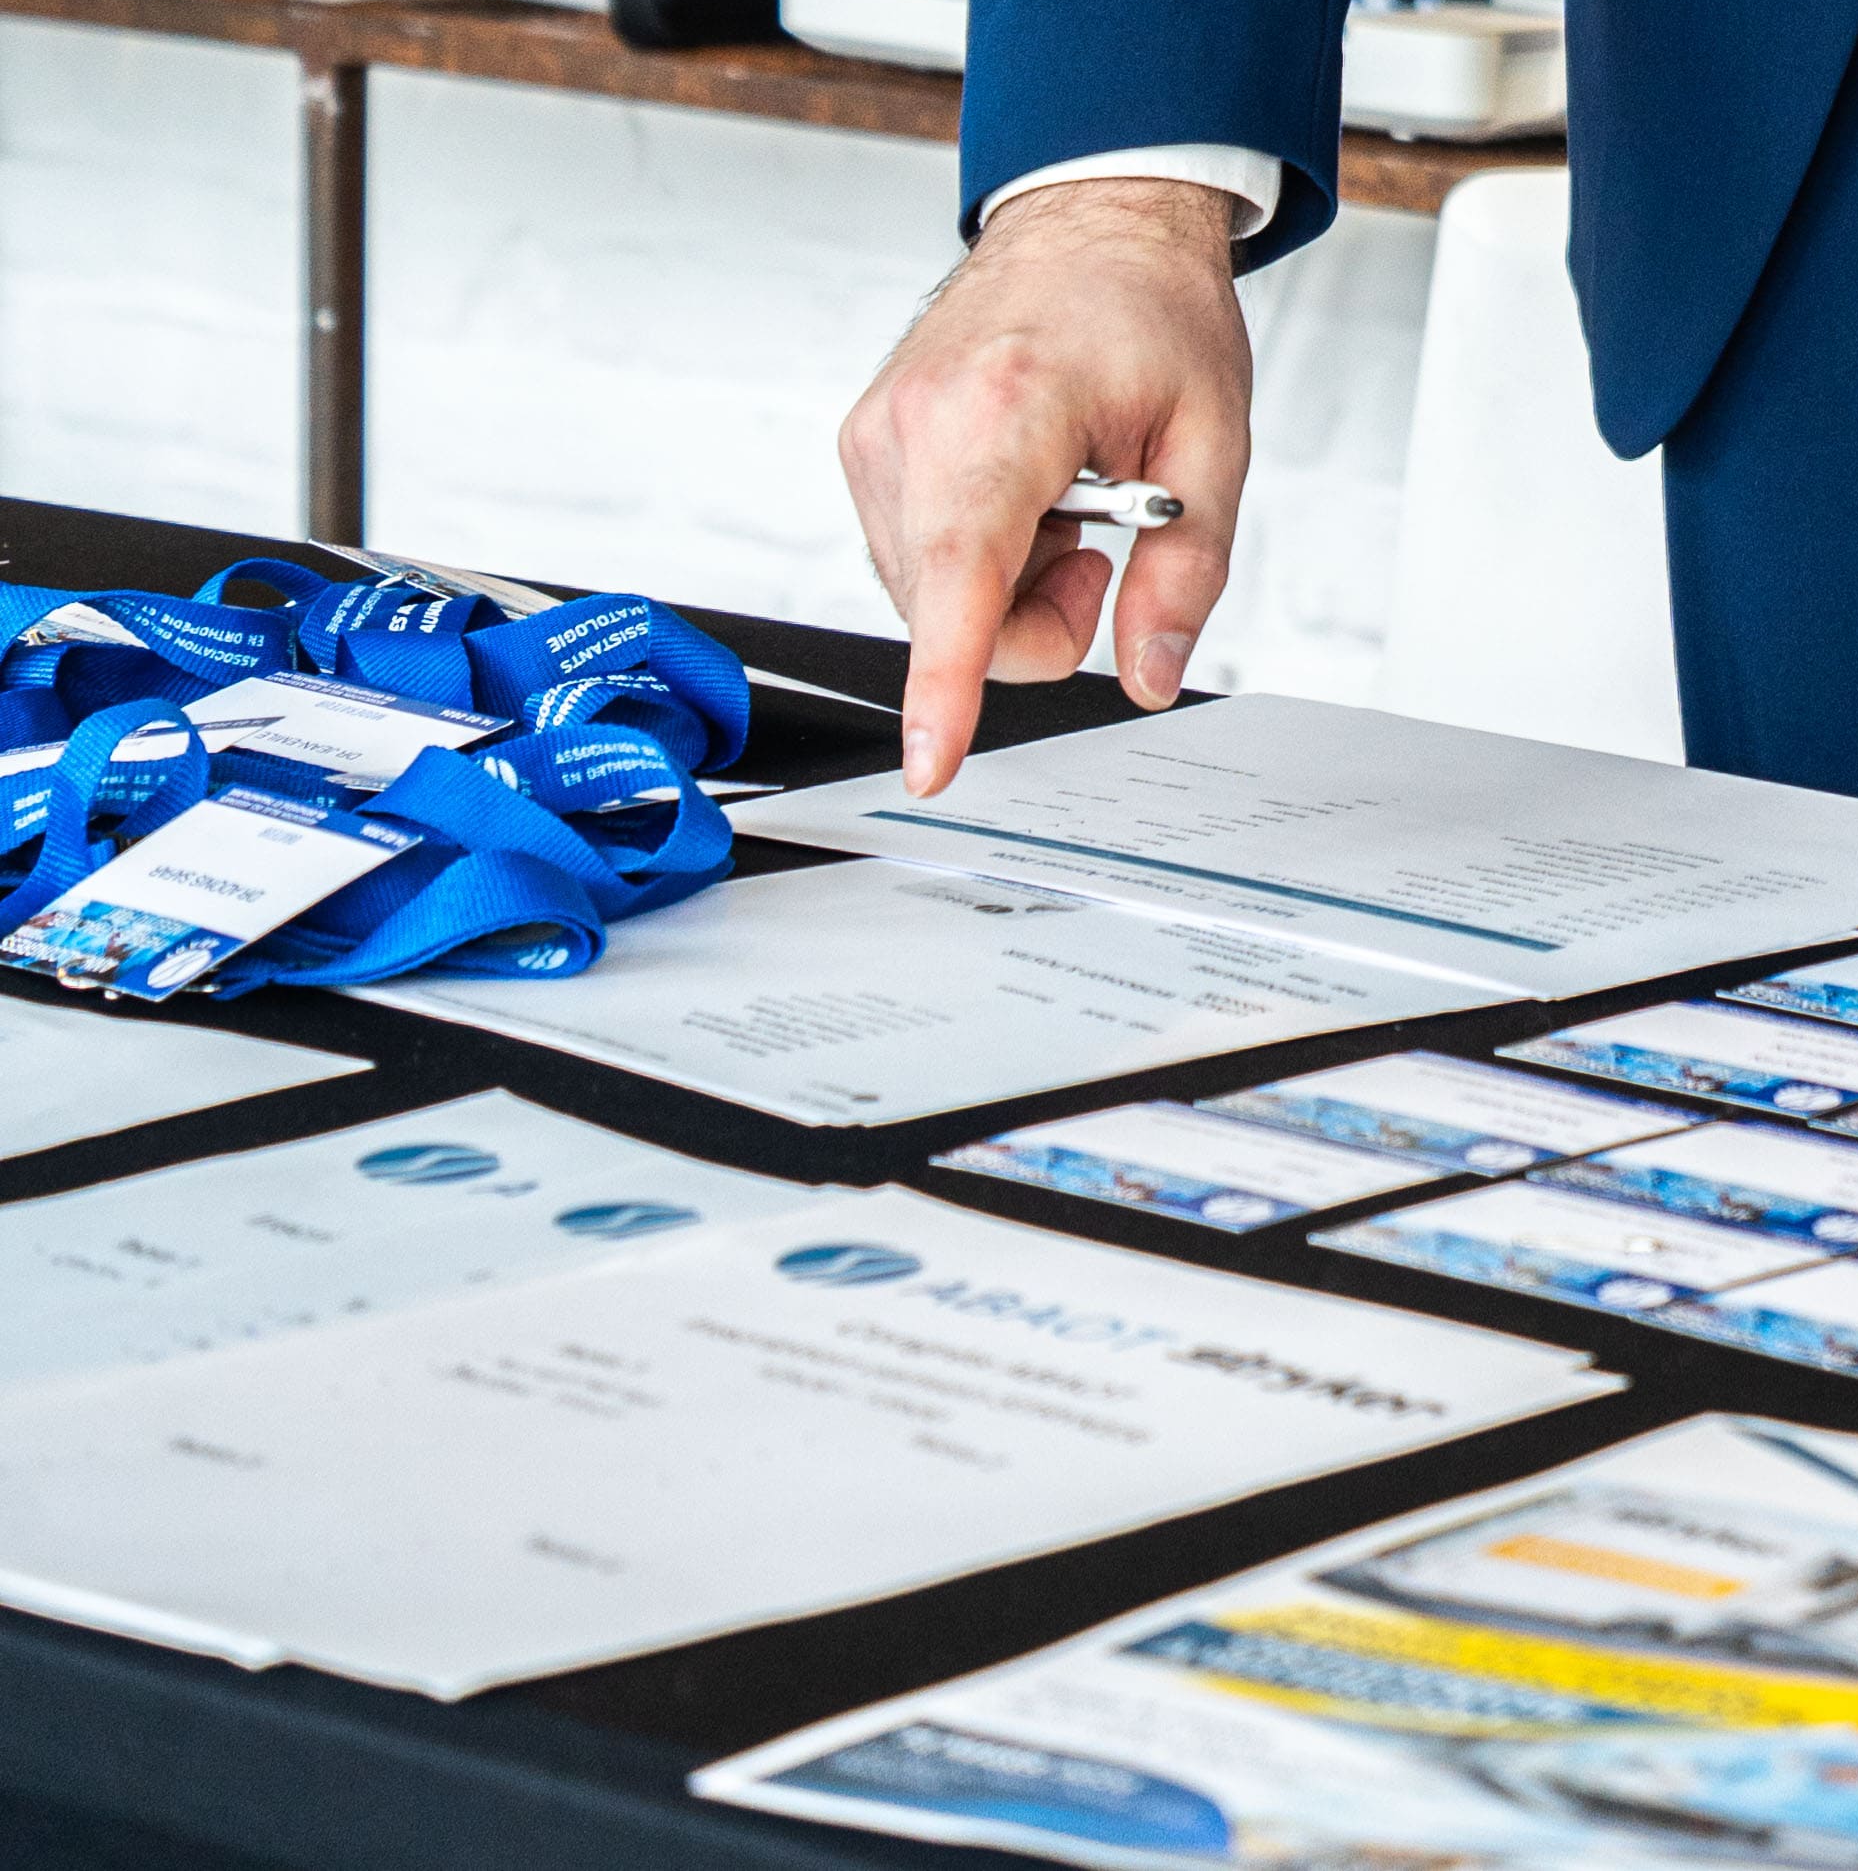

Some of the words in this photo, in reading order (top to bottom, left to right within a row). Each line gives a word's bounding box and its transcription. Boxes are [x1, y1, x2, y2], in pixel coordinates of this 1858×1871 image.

[173, 636, 259, 668] ASSOCIATION
[247, 633, 265, 647] EN
[559, 622, 649, 674] SSISTANTS
